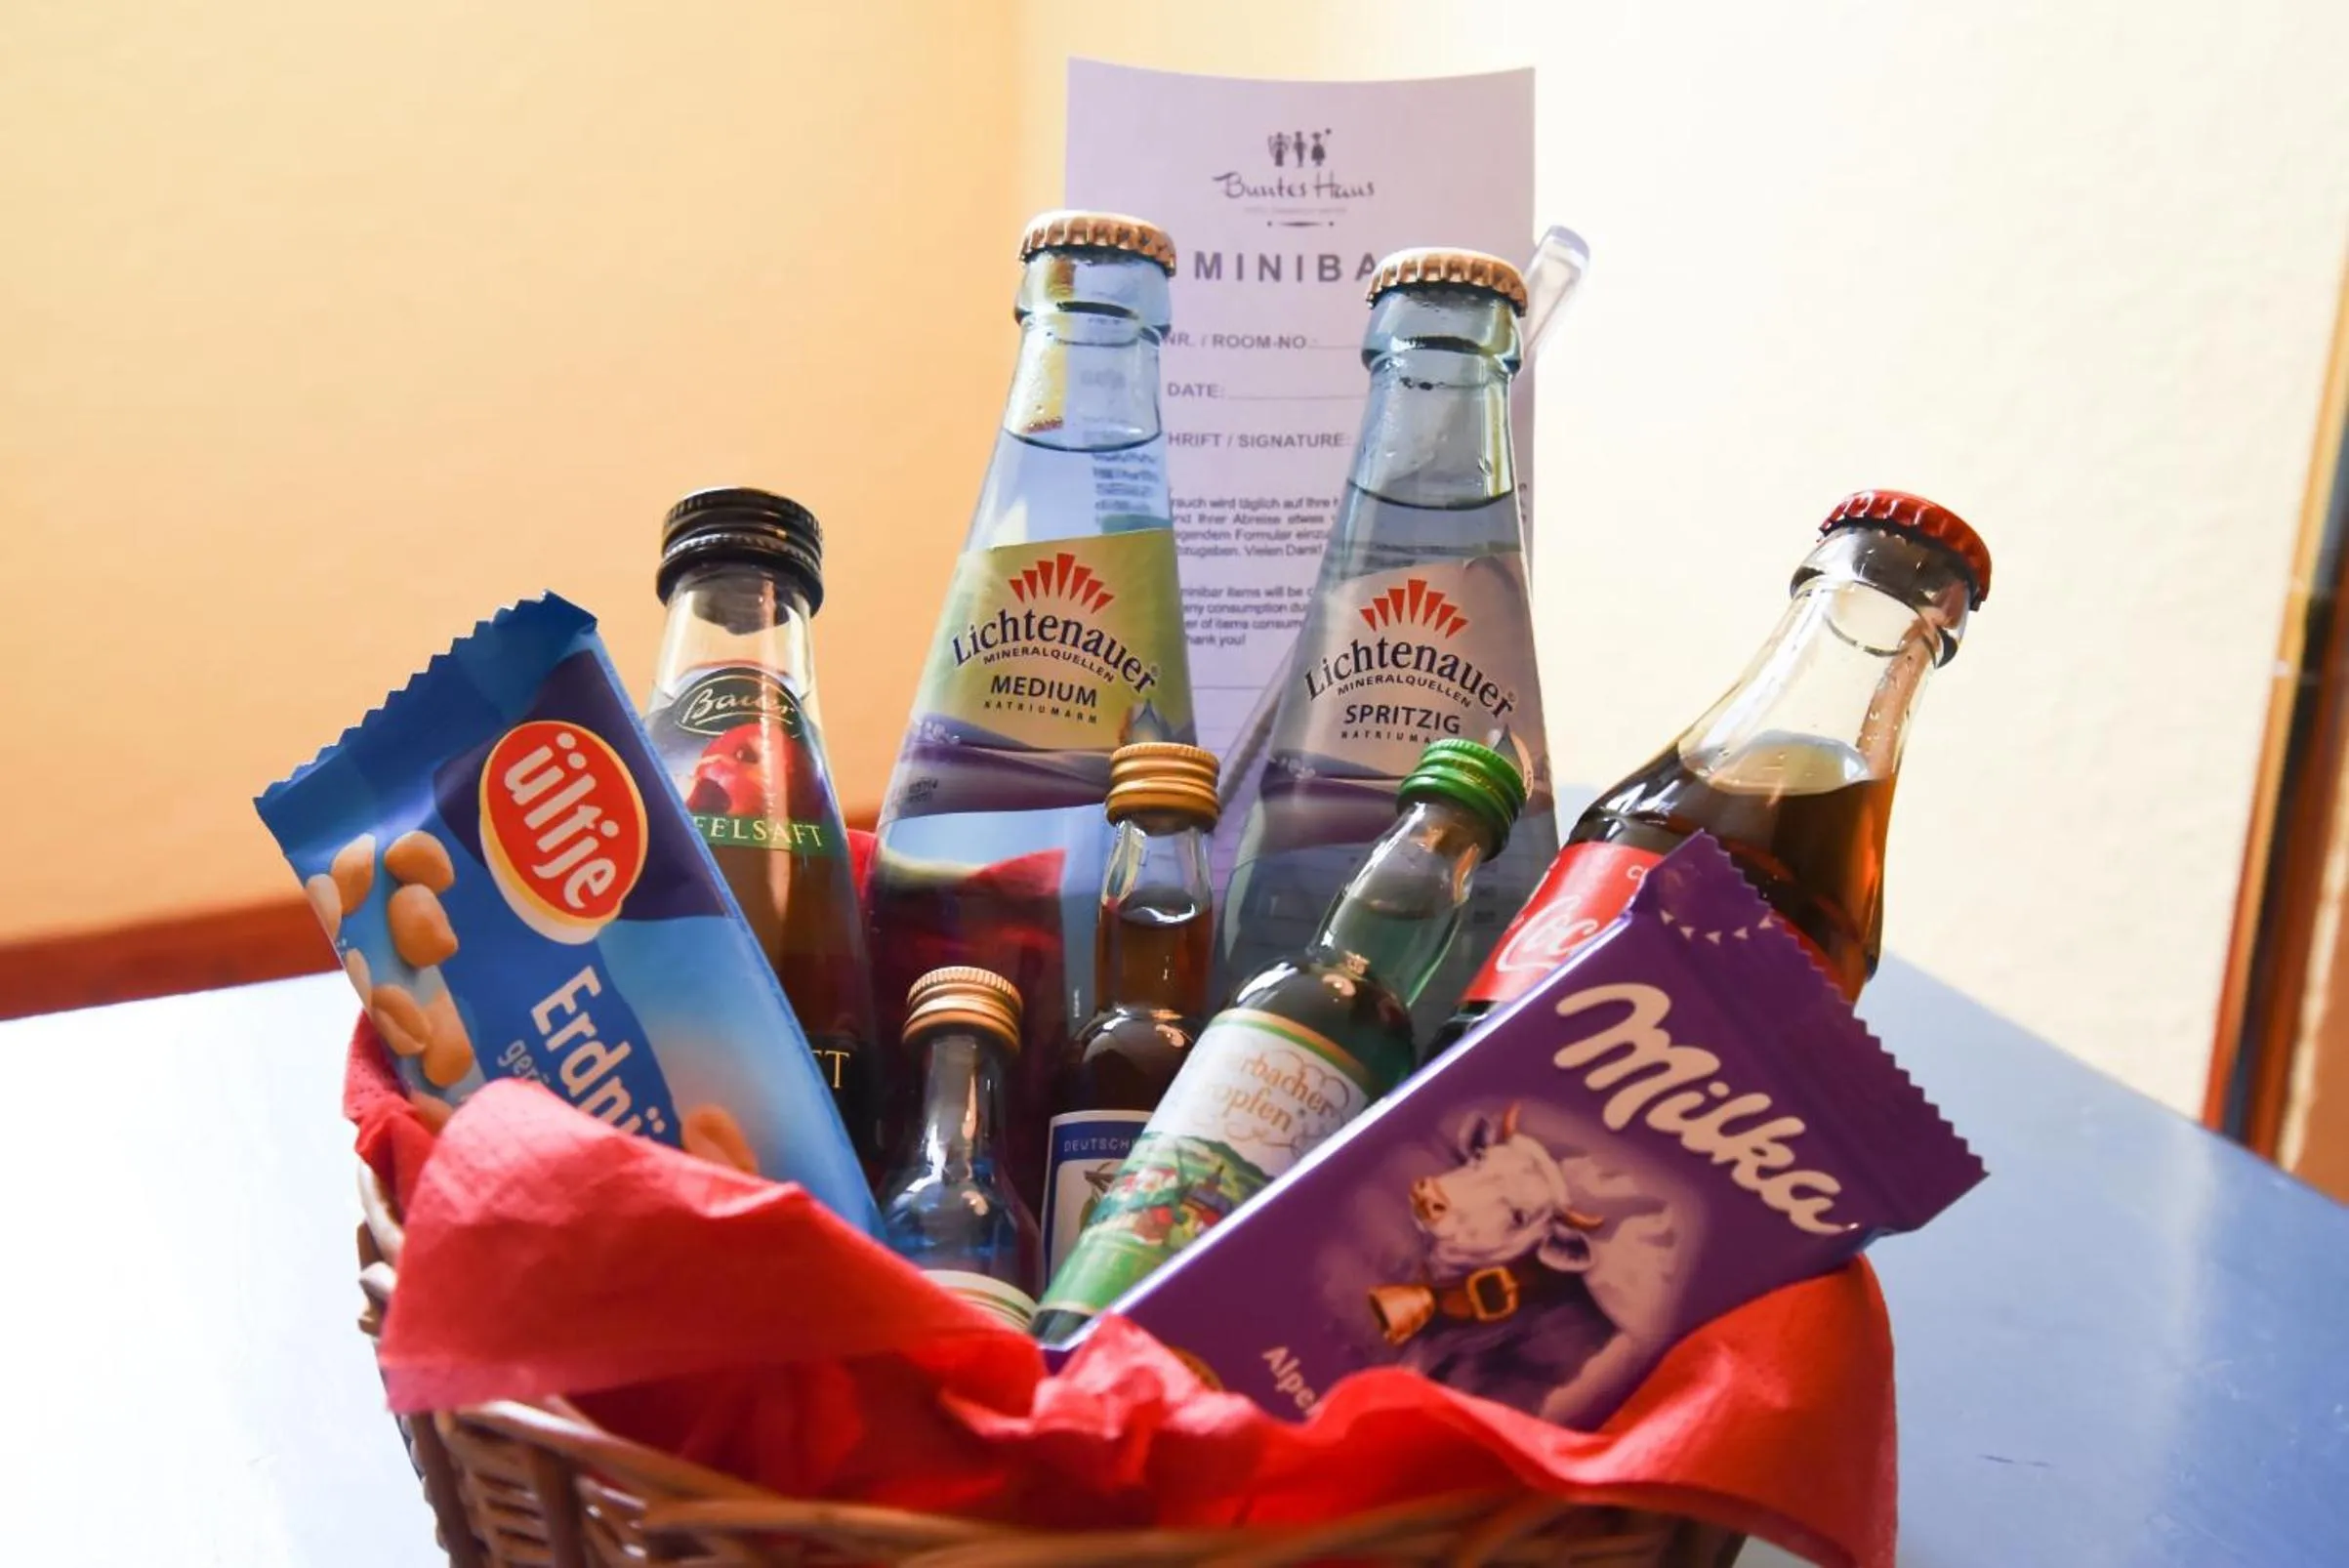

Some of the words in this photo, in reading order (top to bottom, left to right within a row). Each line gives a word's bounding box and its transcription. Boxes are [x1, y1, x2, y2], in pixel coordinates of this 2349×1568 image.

[953, 608, 1155, 693] Lichtenauer
[983, 645, 1114, 682] MINERALQUELLEN
[991, 675, 1097, 708] MEDIUM
[1304, 637, 1513, 719] Lichtenauer
[1338, 673, 1470, 708] MINERALQUELLEN
[983, 700, 1096, 723] NATRIUMARM
[1343, 704, 1461, 734] SPRITZIG
[504, 732, 619, 909] ültje
[1553, 982, 1851, 1234] Milka
